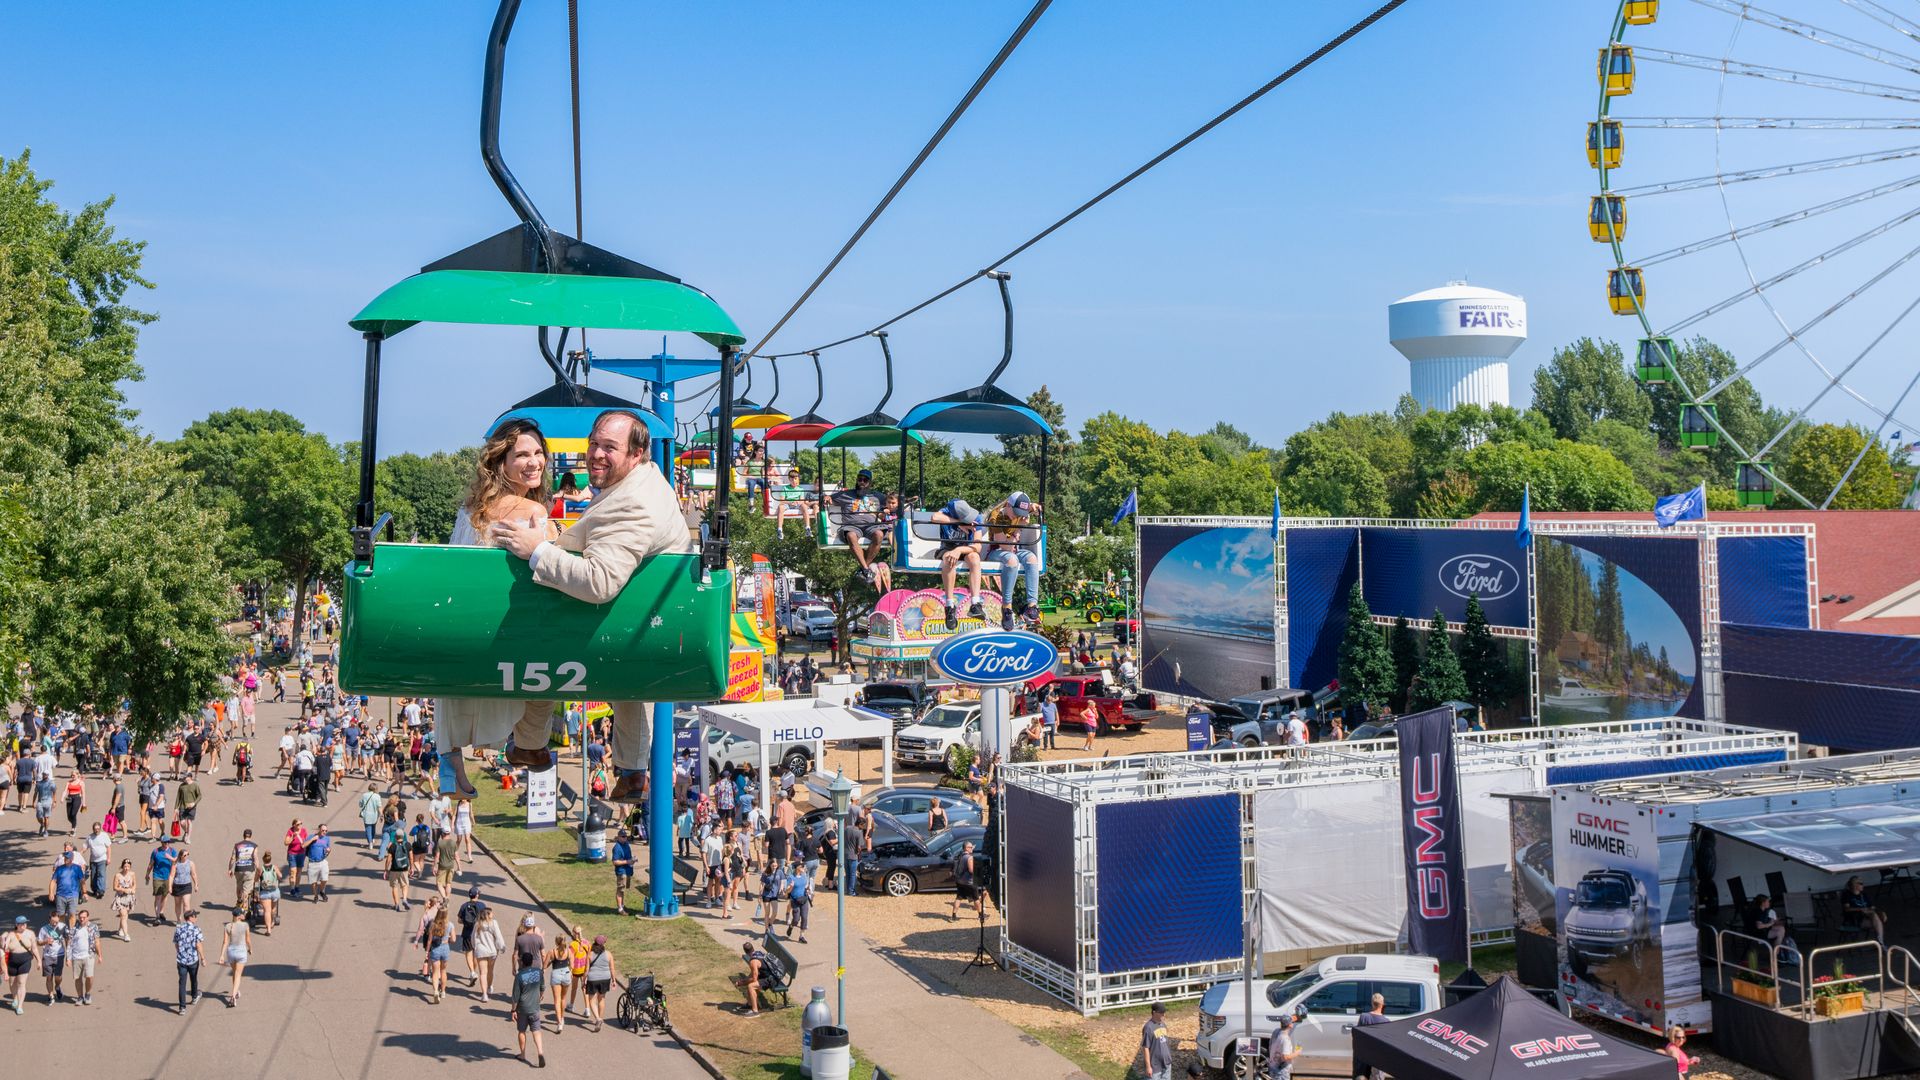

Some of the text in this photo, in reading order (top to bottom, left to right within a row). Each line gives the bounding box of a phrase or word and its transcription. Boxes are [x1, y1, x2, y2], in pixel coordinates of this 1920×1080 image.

[1460, 311, 1516, 328] FAIR
[1453, 559, 1504, 593] Ford
[730, 655, 751, 672] resh
[964, 641, 1035, 674] Ford
[497, 661, 588, 692] 152
[701, 712, 718, 726] HELLO
[773, 726, 823, 742] HELLO
[1577, 812, 1630, 835] GMC
[1412, 753, 1450, 920] GMC
[1570, 828, 1625, 856] HUMMER
[1417, 1018, 1489, 1055] GMC
[1510, 1034, 1601, 1059] GMC
[1534, 1059, 1548, 1067] ARE
[1547, 1053, 1590, 1065] PROFESSIONAL
[1588, 1050, 1609, 1059] GRADE
